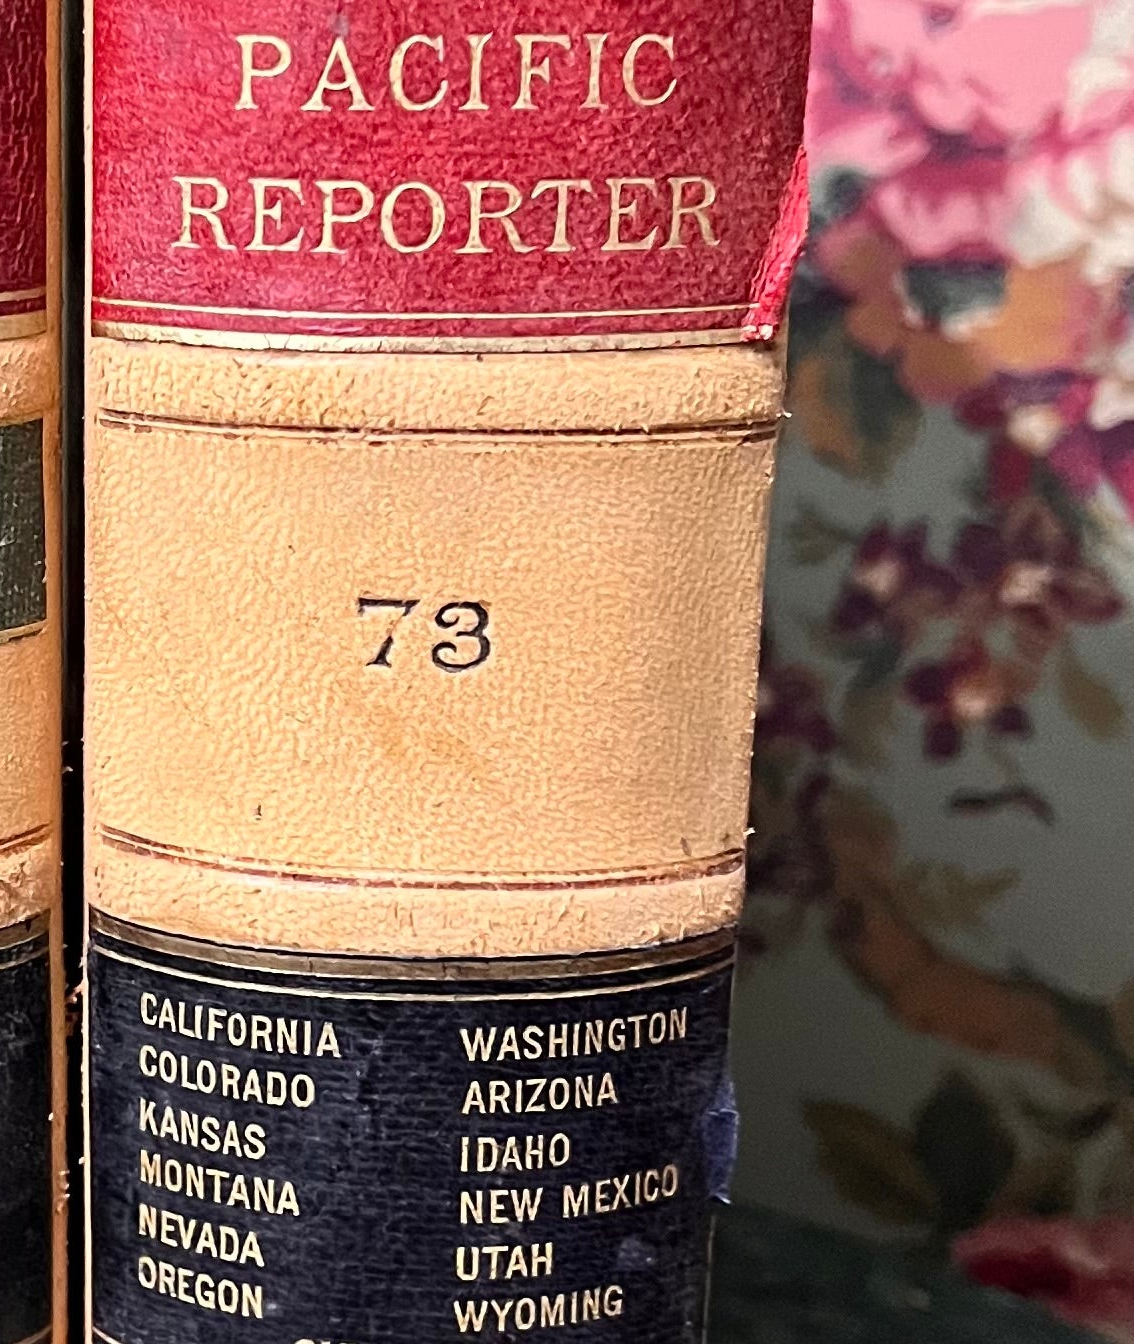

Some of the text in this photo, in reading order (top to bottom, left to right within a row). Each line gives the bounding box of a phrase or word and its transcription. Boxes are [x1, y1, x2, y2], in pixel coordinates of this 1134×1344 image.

[233, 32, 678, 114] PACIFIC
[170, 175, 721, 256] REPORTER
[356, 596, 493, 673] 73
[139, 991, 342, 1058] CALIFORNIA
[459, 1006, 690, 1062] WASHINGTON
[139, 1045, 316, 1109] COLORADO
[461, 1072, 619, 1116] ARIZONA
[139, 1097, 267, 1160] KANSAS
[460, 1132, 572, 1173] IDAHO
[139, 1149, 300, 1217] MONTANA
[460, 1163, 680, 1226] NEW MEXICO
[138, 1203, 265, 1267] NEVADA
[455, 1241, 554, 1282] UTAH
[137, 1256, 264, 1320] OREGON
[453, 1285, 625, 1334] WYOMING
